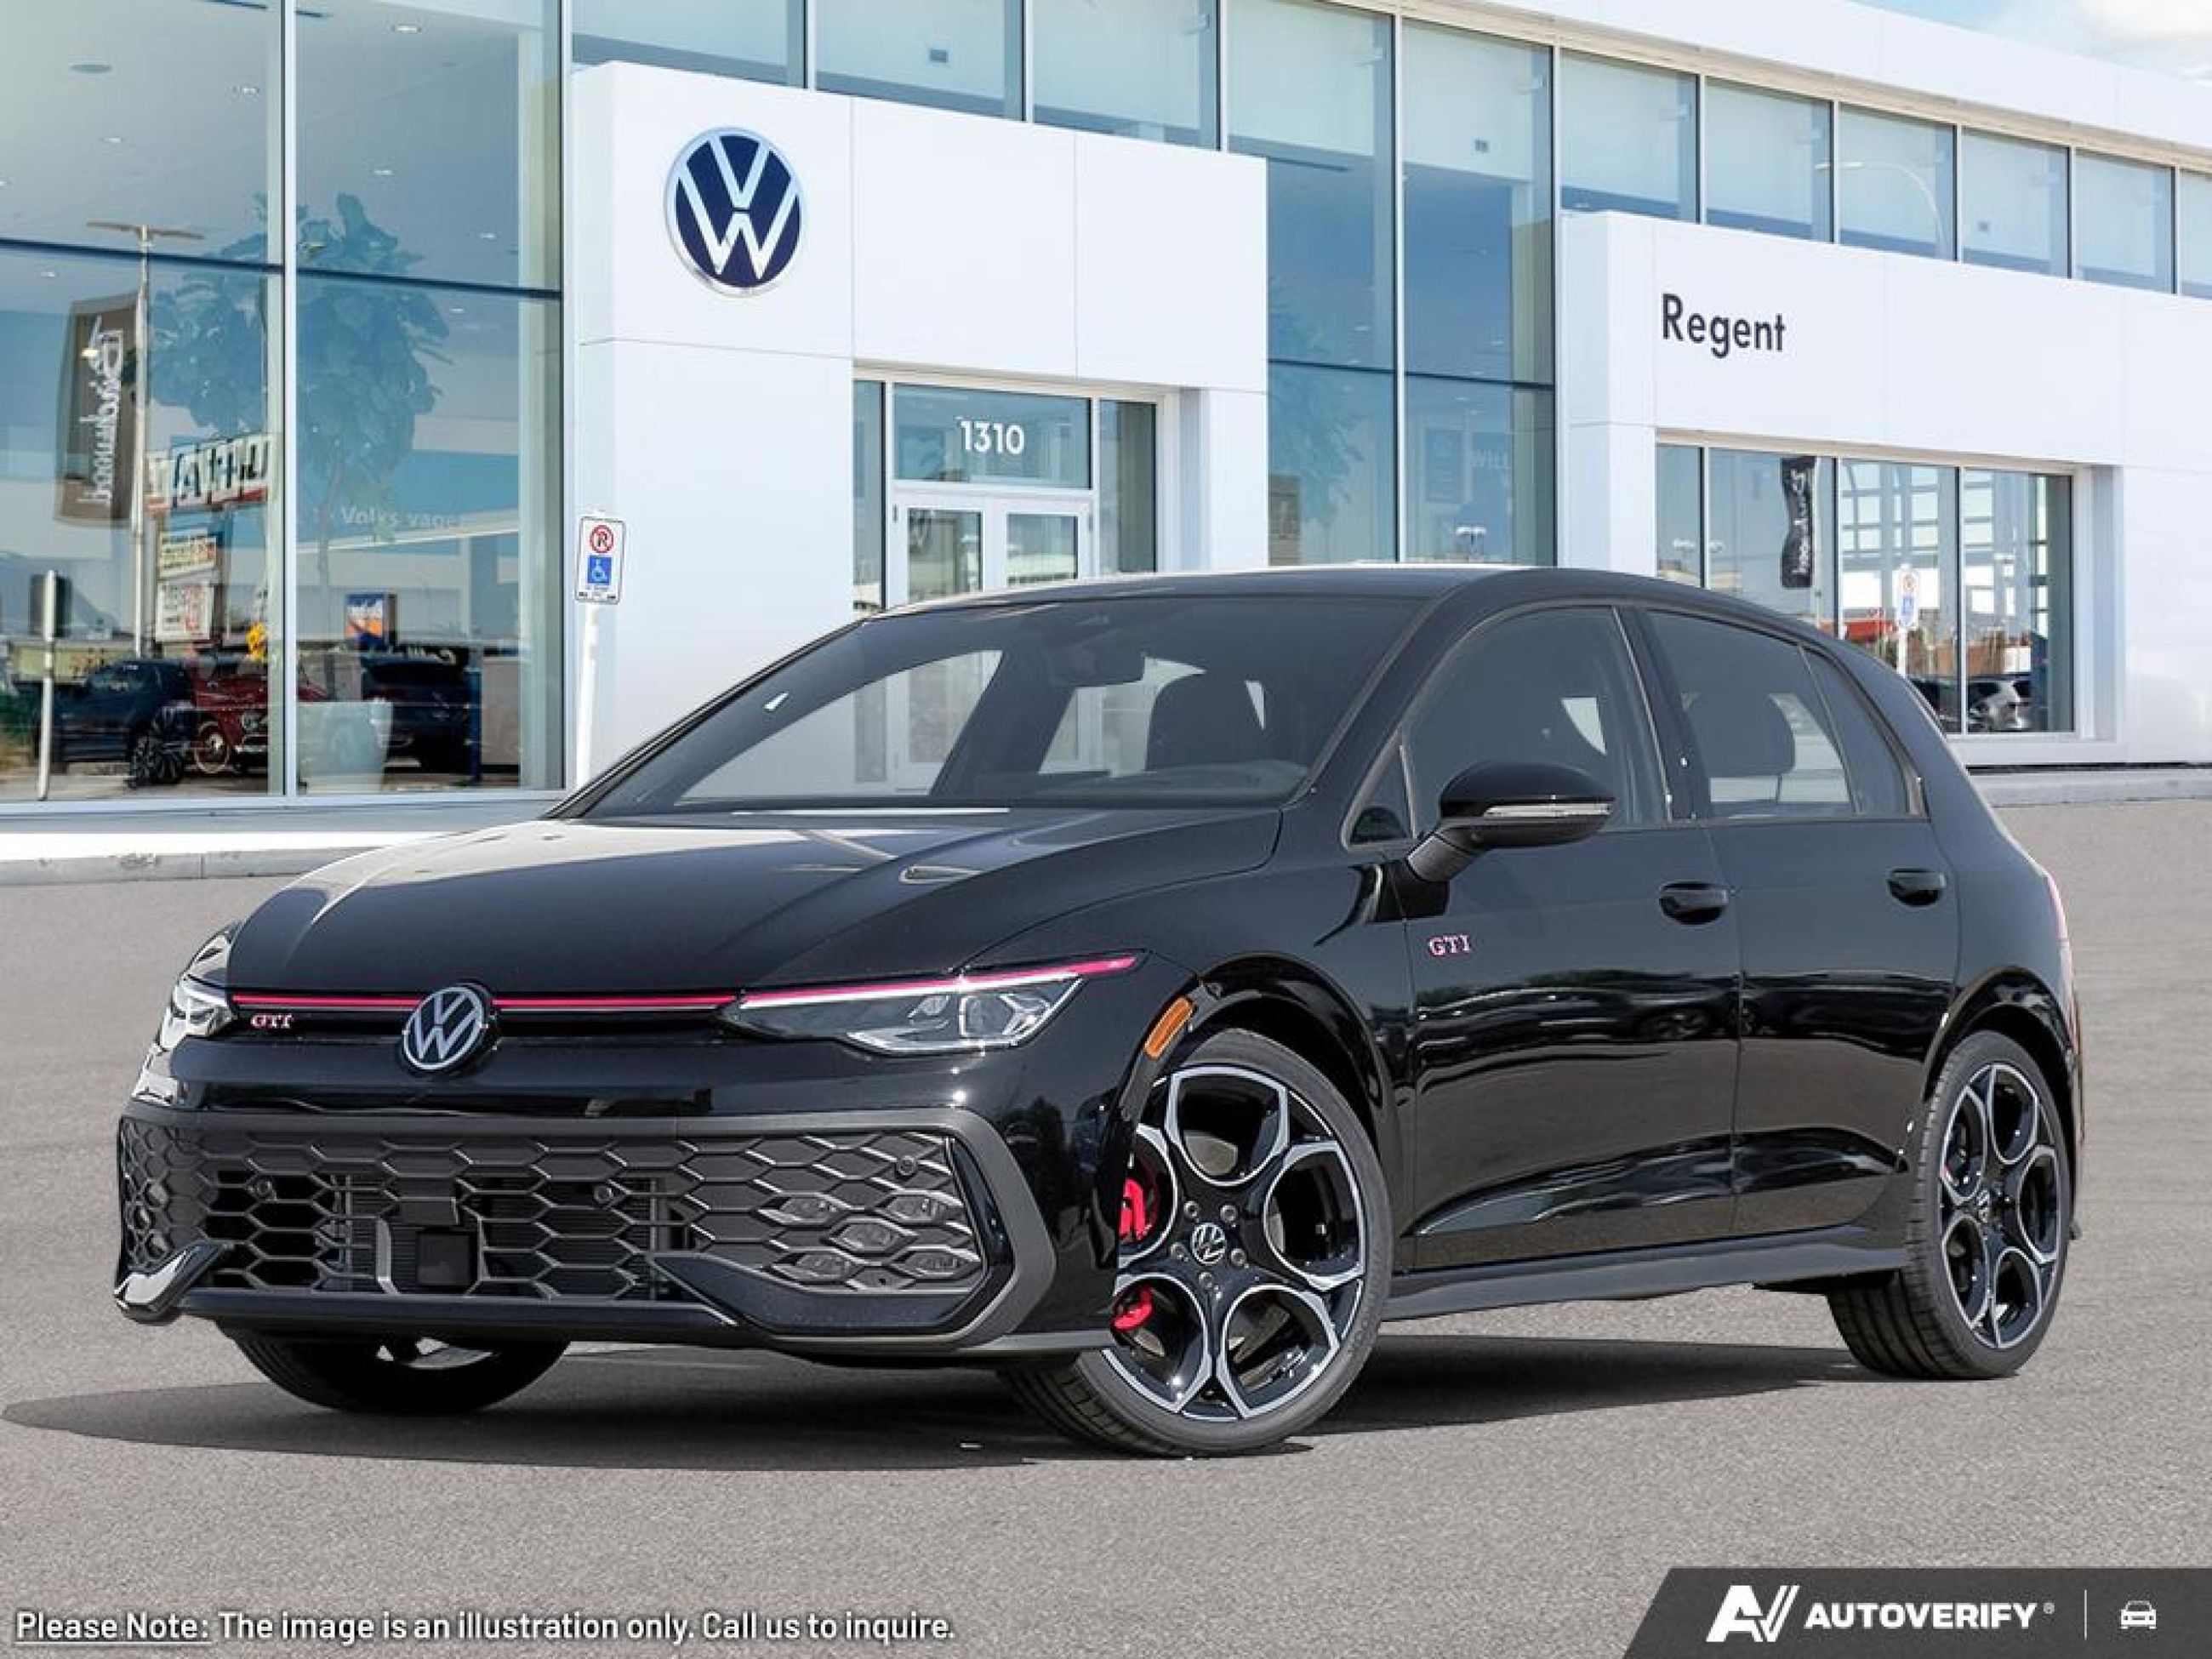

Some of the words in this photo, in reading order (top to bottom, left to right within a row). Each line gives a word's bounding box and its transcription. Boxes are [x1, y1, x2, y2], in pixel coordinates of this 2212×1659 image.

[1662, 292, 1786, 359] Regent
[960, 419, 1025, 454] 1310
[1428, 934, 1470, 955] GTI
[250, 1013, 292, 1029] GTI
